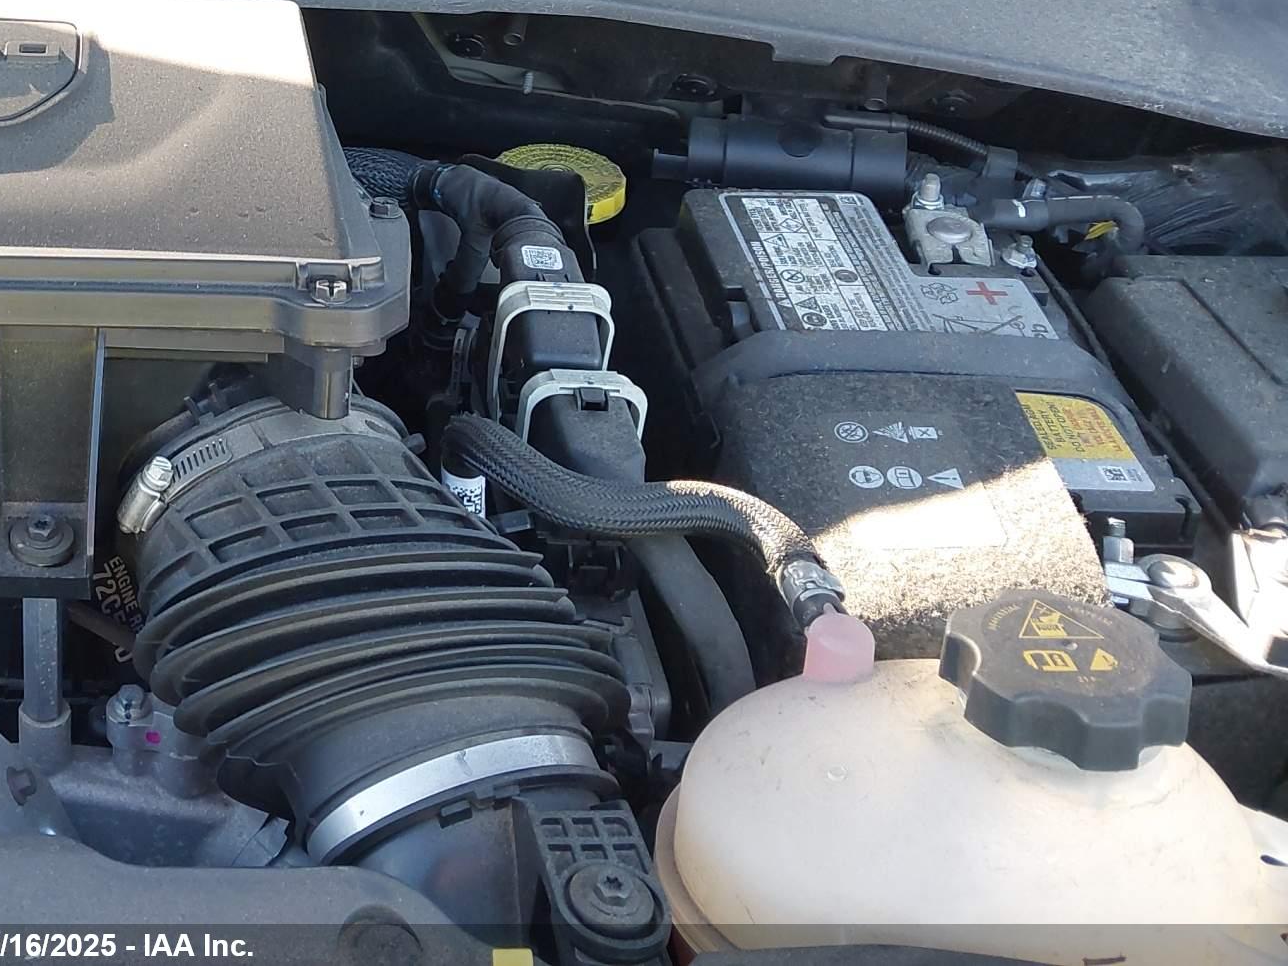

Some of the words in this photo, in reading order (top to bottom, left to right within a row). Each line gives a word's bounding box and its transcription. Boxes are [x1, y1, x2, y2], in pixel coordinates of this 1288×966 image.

[1031, 420, 1057, 450] SEALED
[1037, 409, 1066, 442] BATTERY
[110, 556, 139, 612] ENGINE
